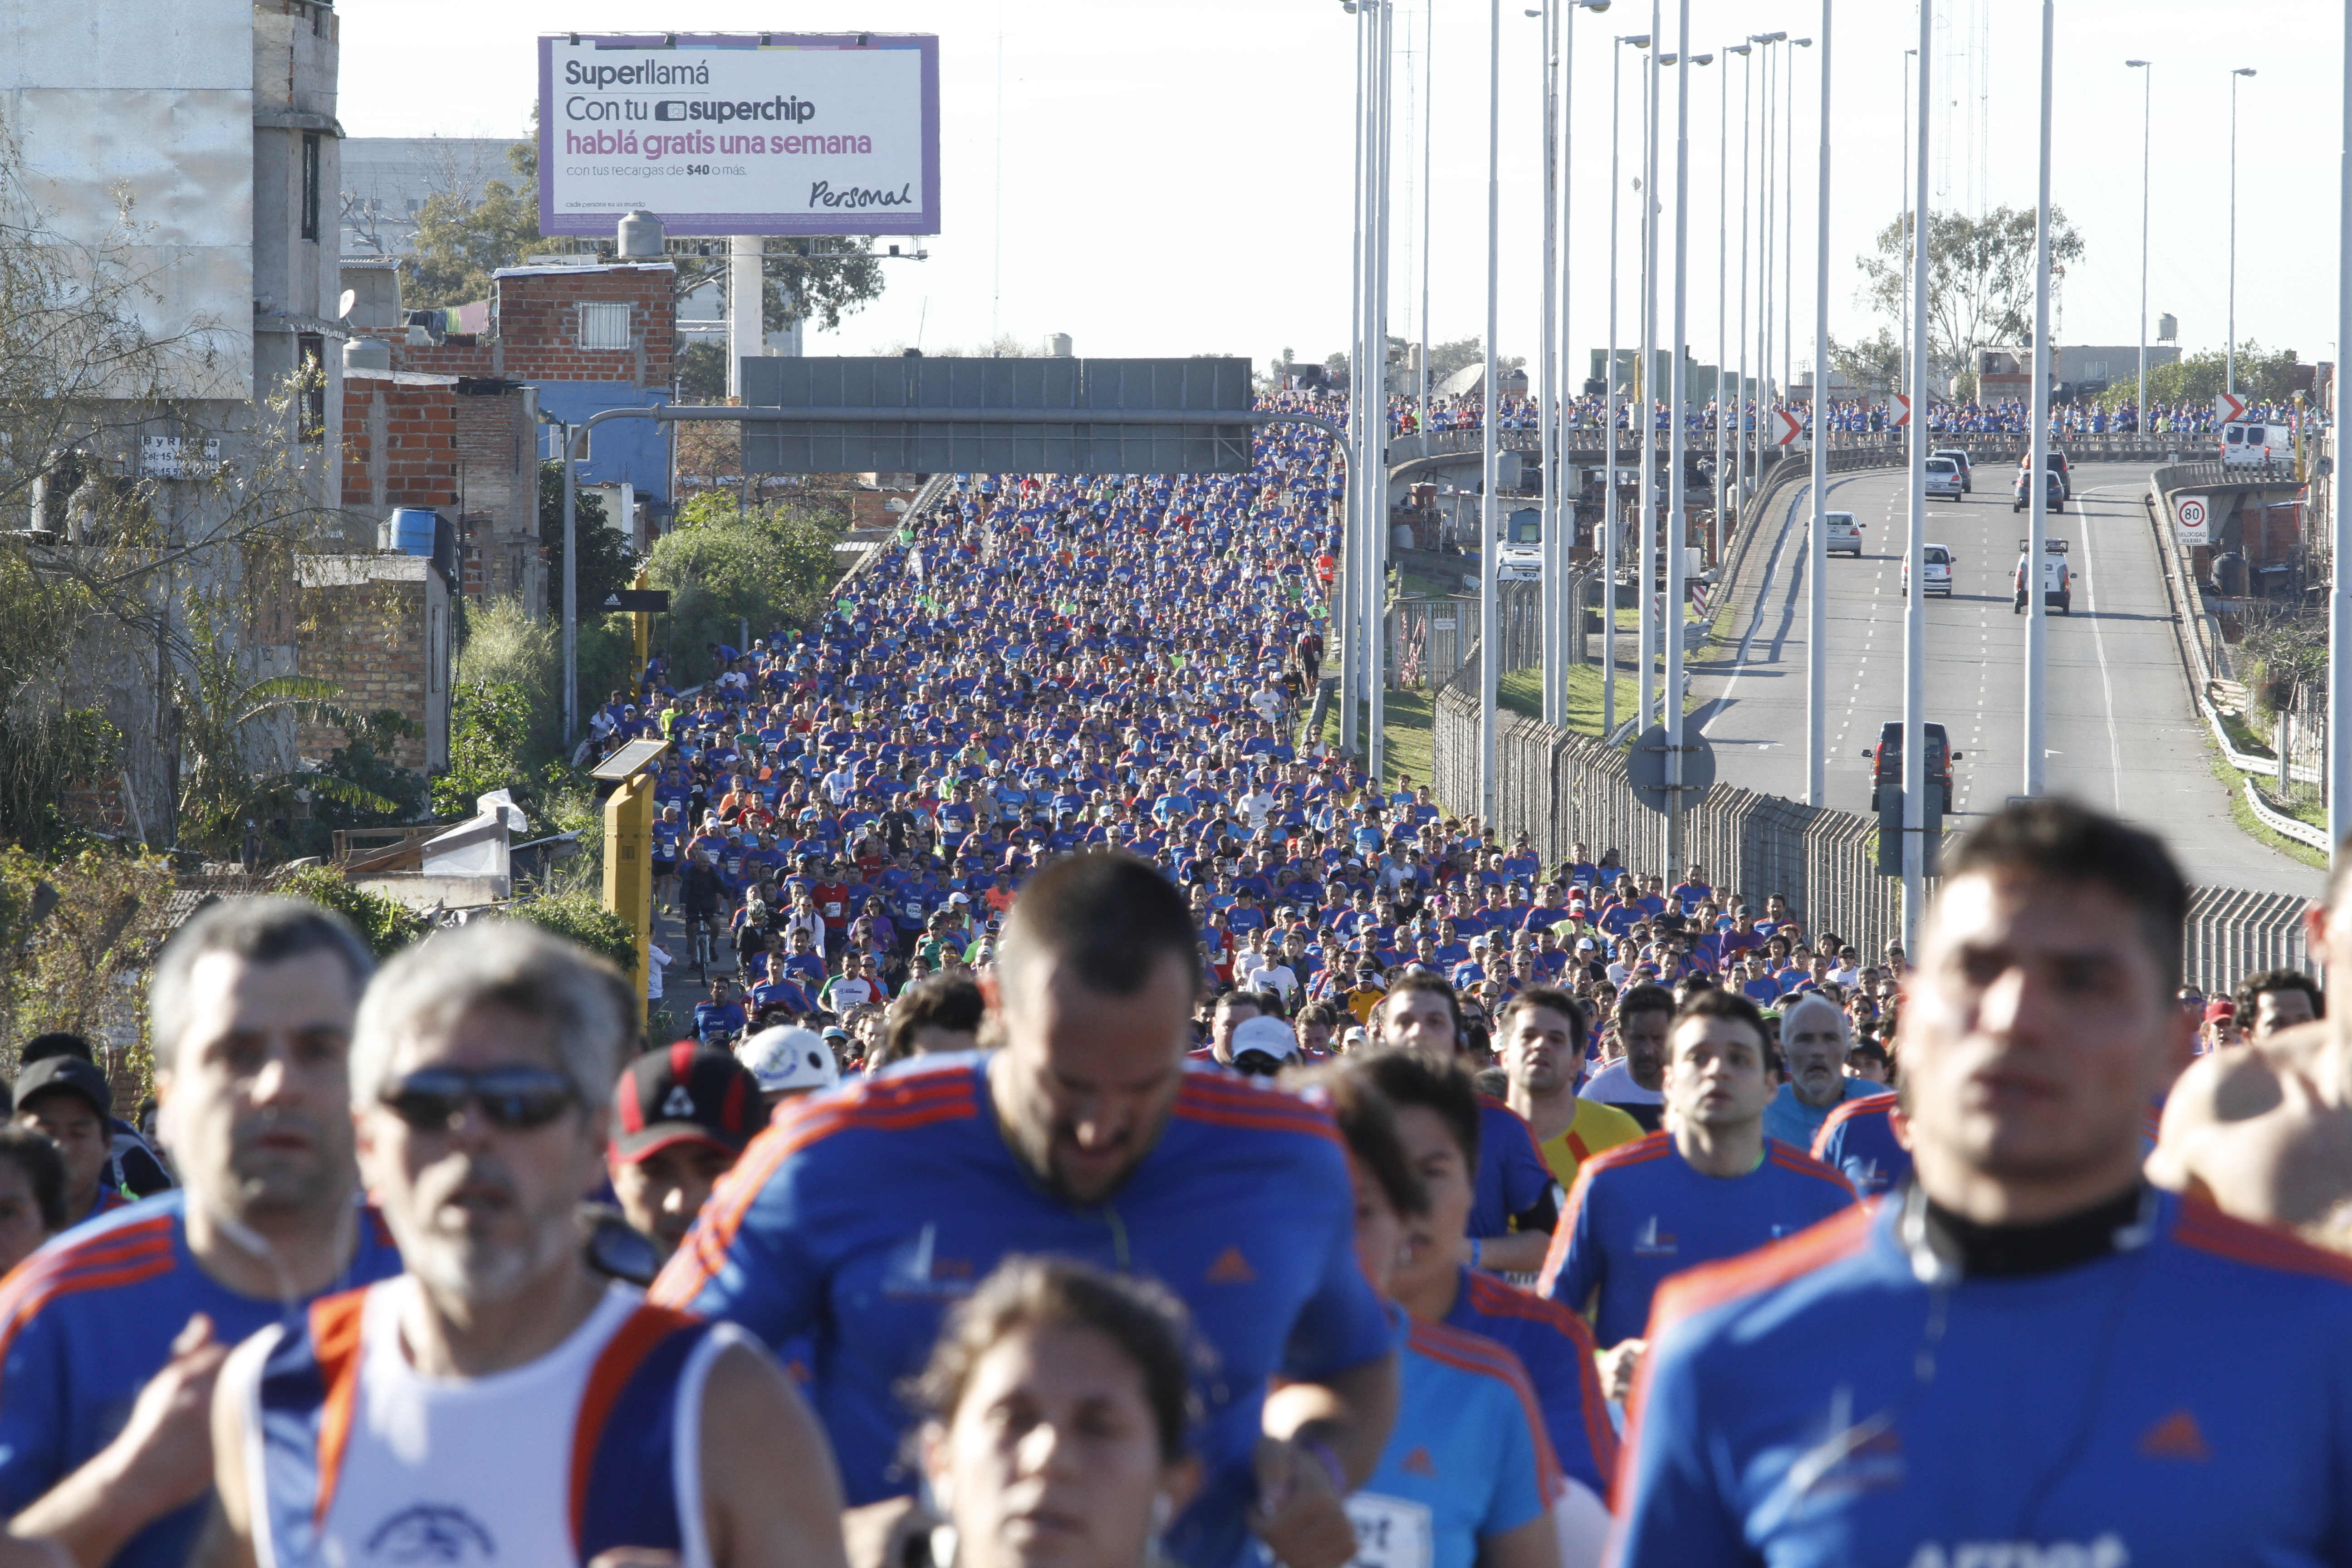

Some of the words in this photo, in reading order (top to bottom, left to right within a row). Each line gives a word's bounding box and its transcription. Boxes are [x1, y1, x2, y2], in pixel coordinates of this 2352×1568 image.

[565, 59, 709, 90] Superllamá
[566, 96, 619, 121] Con
[623, 99, 647, 121] tu
[689, 95, 815, 124] superchip
[567, 129, 637, 154] hablá
[643, 129, 715, 160] gratis
[720, 135, 765, 154] una
[770, 135, 872, 154] semana
[566, 167, 590, 176] con
[593, 166, 609, 176] tus
[612, 167, 664, 178] recargas
[666, 164, 684, 176] de
[686, 164, 710, 176] $40
[711, 167, 721, 176] o
[809, 180, 912, 208] Personal
[2185, 508, 2200, 520] 80
